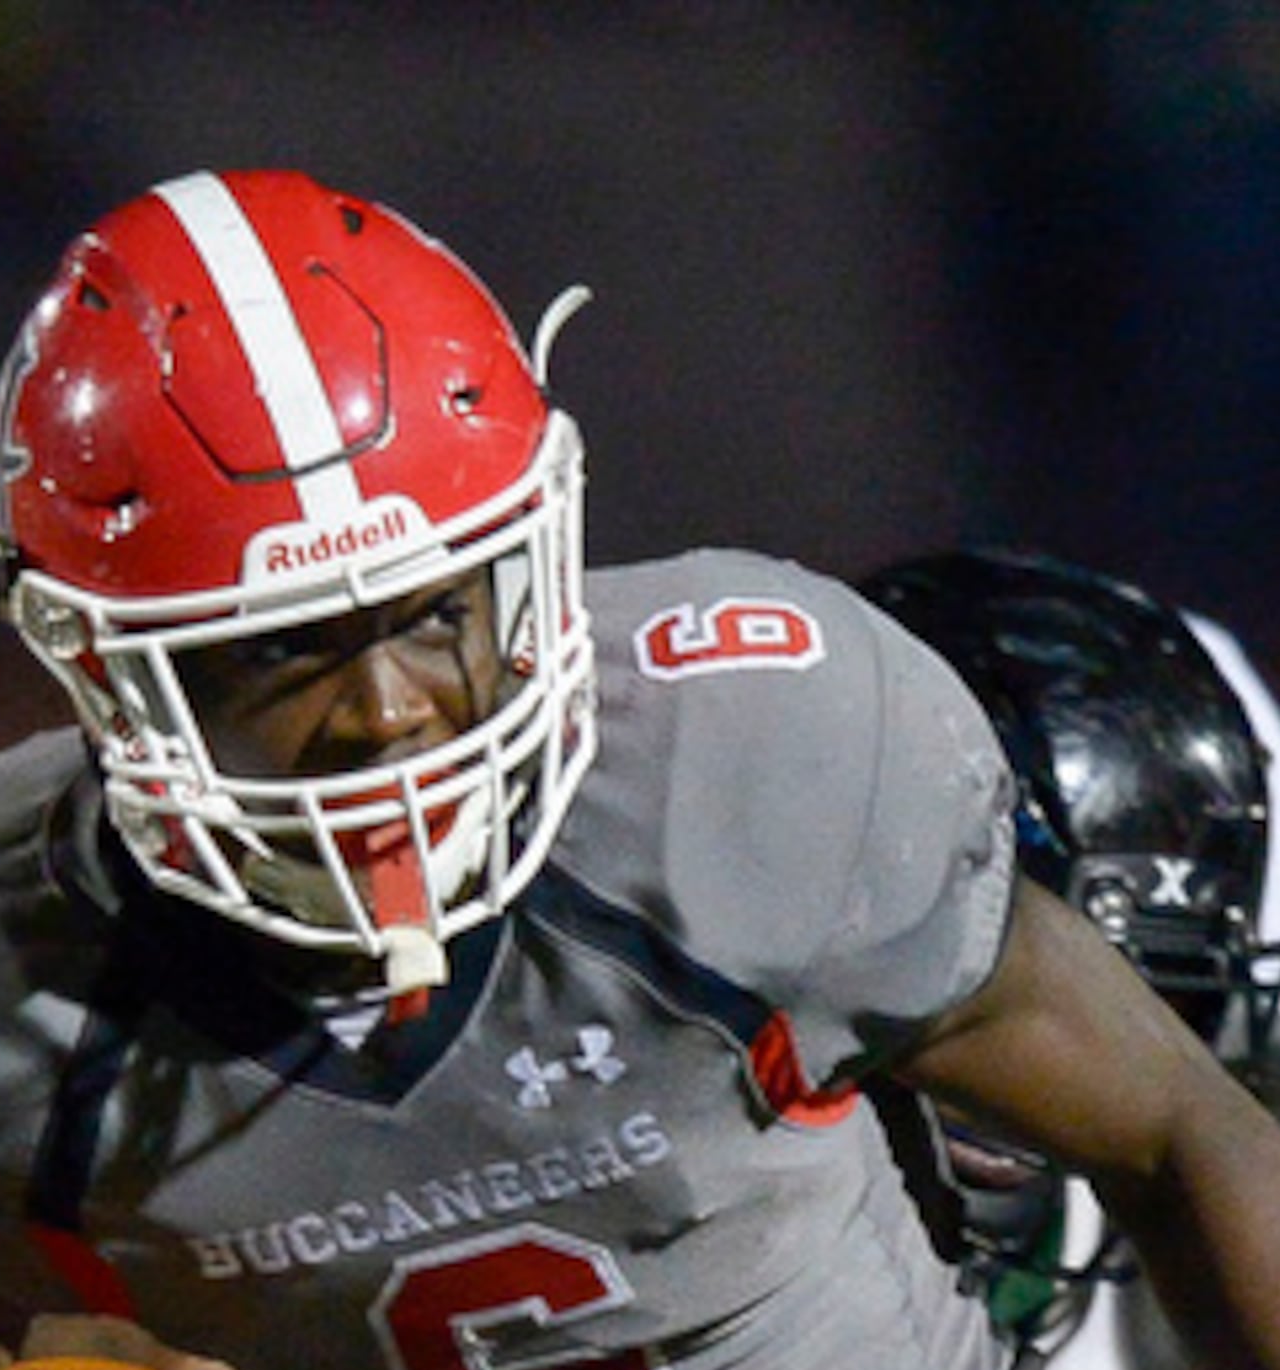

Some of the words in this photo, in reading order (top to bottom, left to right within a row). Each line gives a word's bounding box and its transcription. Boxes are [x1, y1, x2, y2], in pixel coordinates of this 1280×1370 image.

[266, 508, 407, 573] Riddell
[633, 597, 826, 681] 6
[190, 1113, 672, 1280] BUCCANEERS
